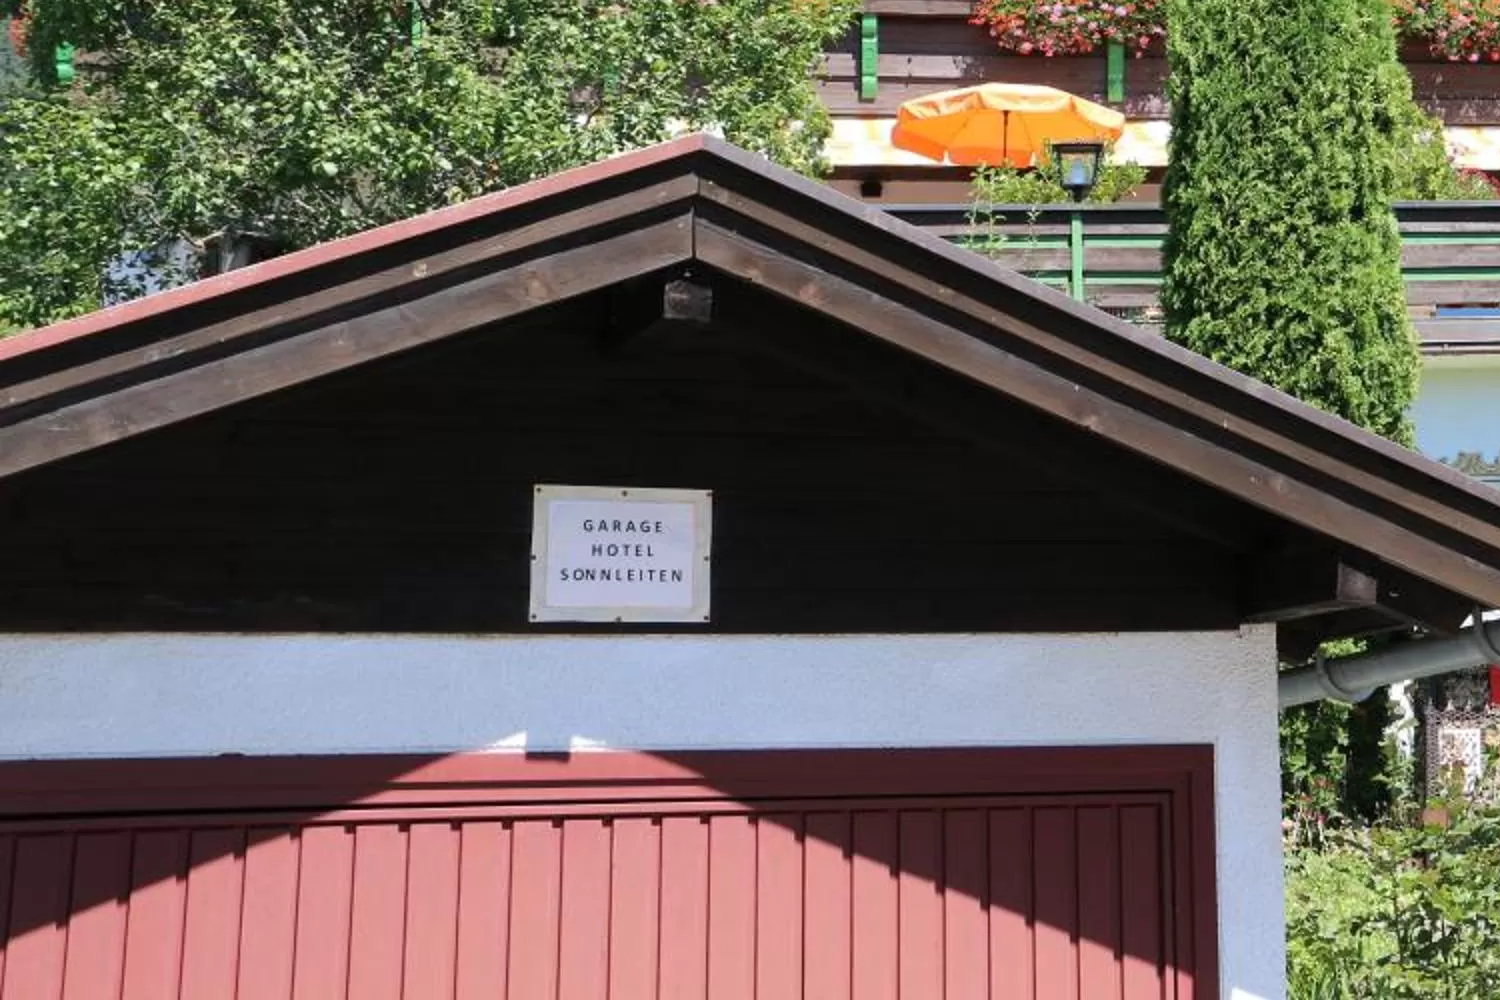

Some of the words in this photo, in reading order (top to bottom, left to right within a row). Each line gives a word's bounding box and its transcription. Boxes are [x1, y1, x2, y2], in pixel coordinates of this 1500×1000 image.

[583, 519, 664, 533] GARAGE
[591, 544, 655, 557] HOTEL
[560, 567, 683, 582] SONNLEITEN
